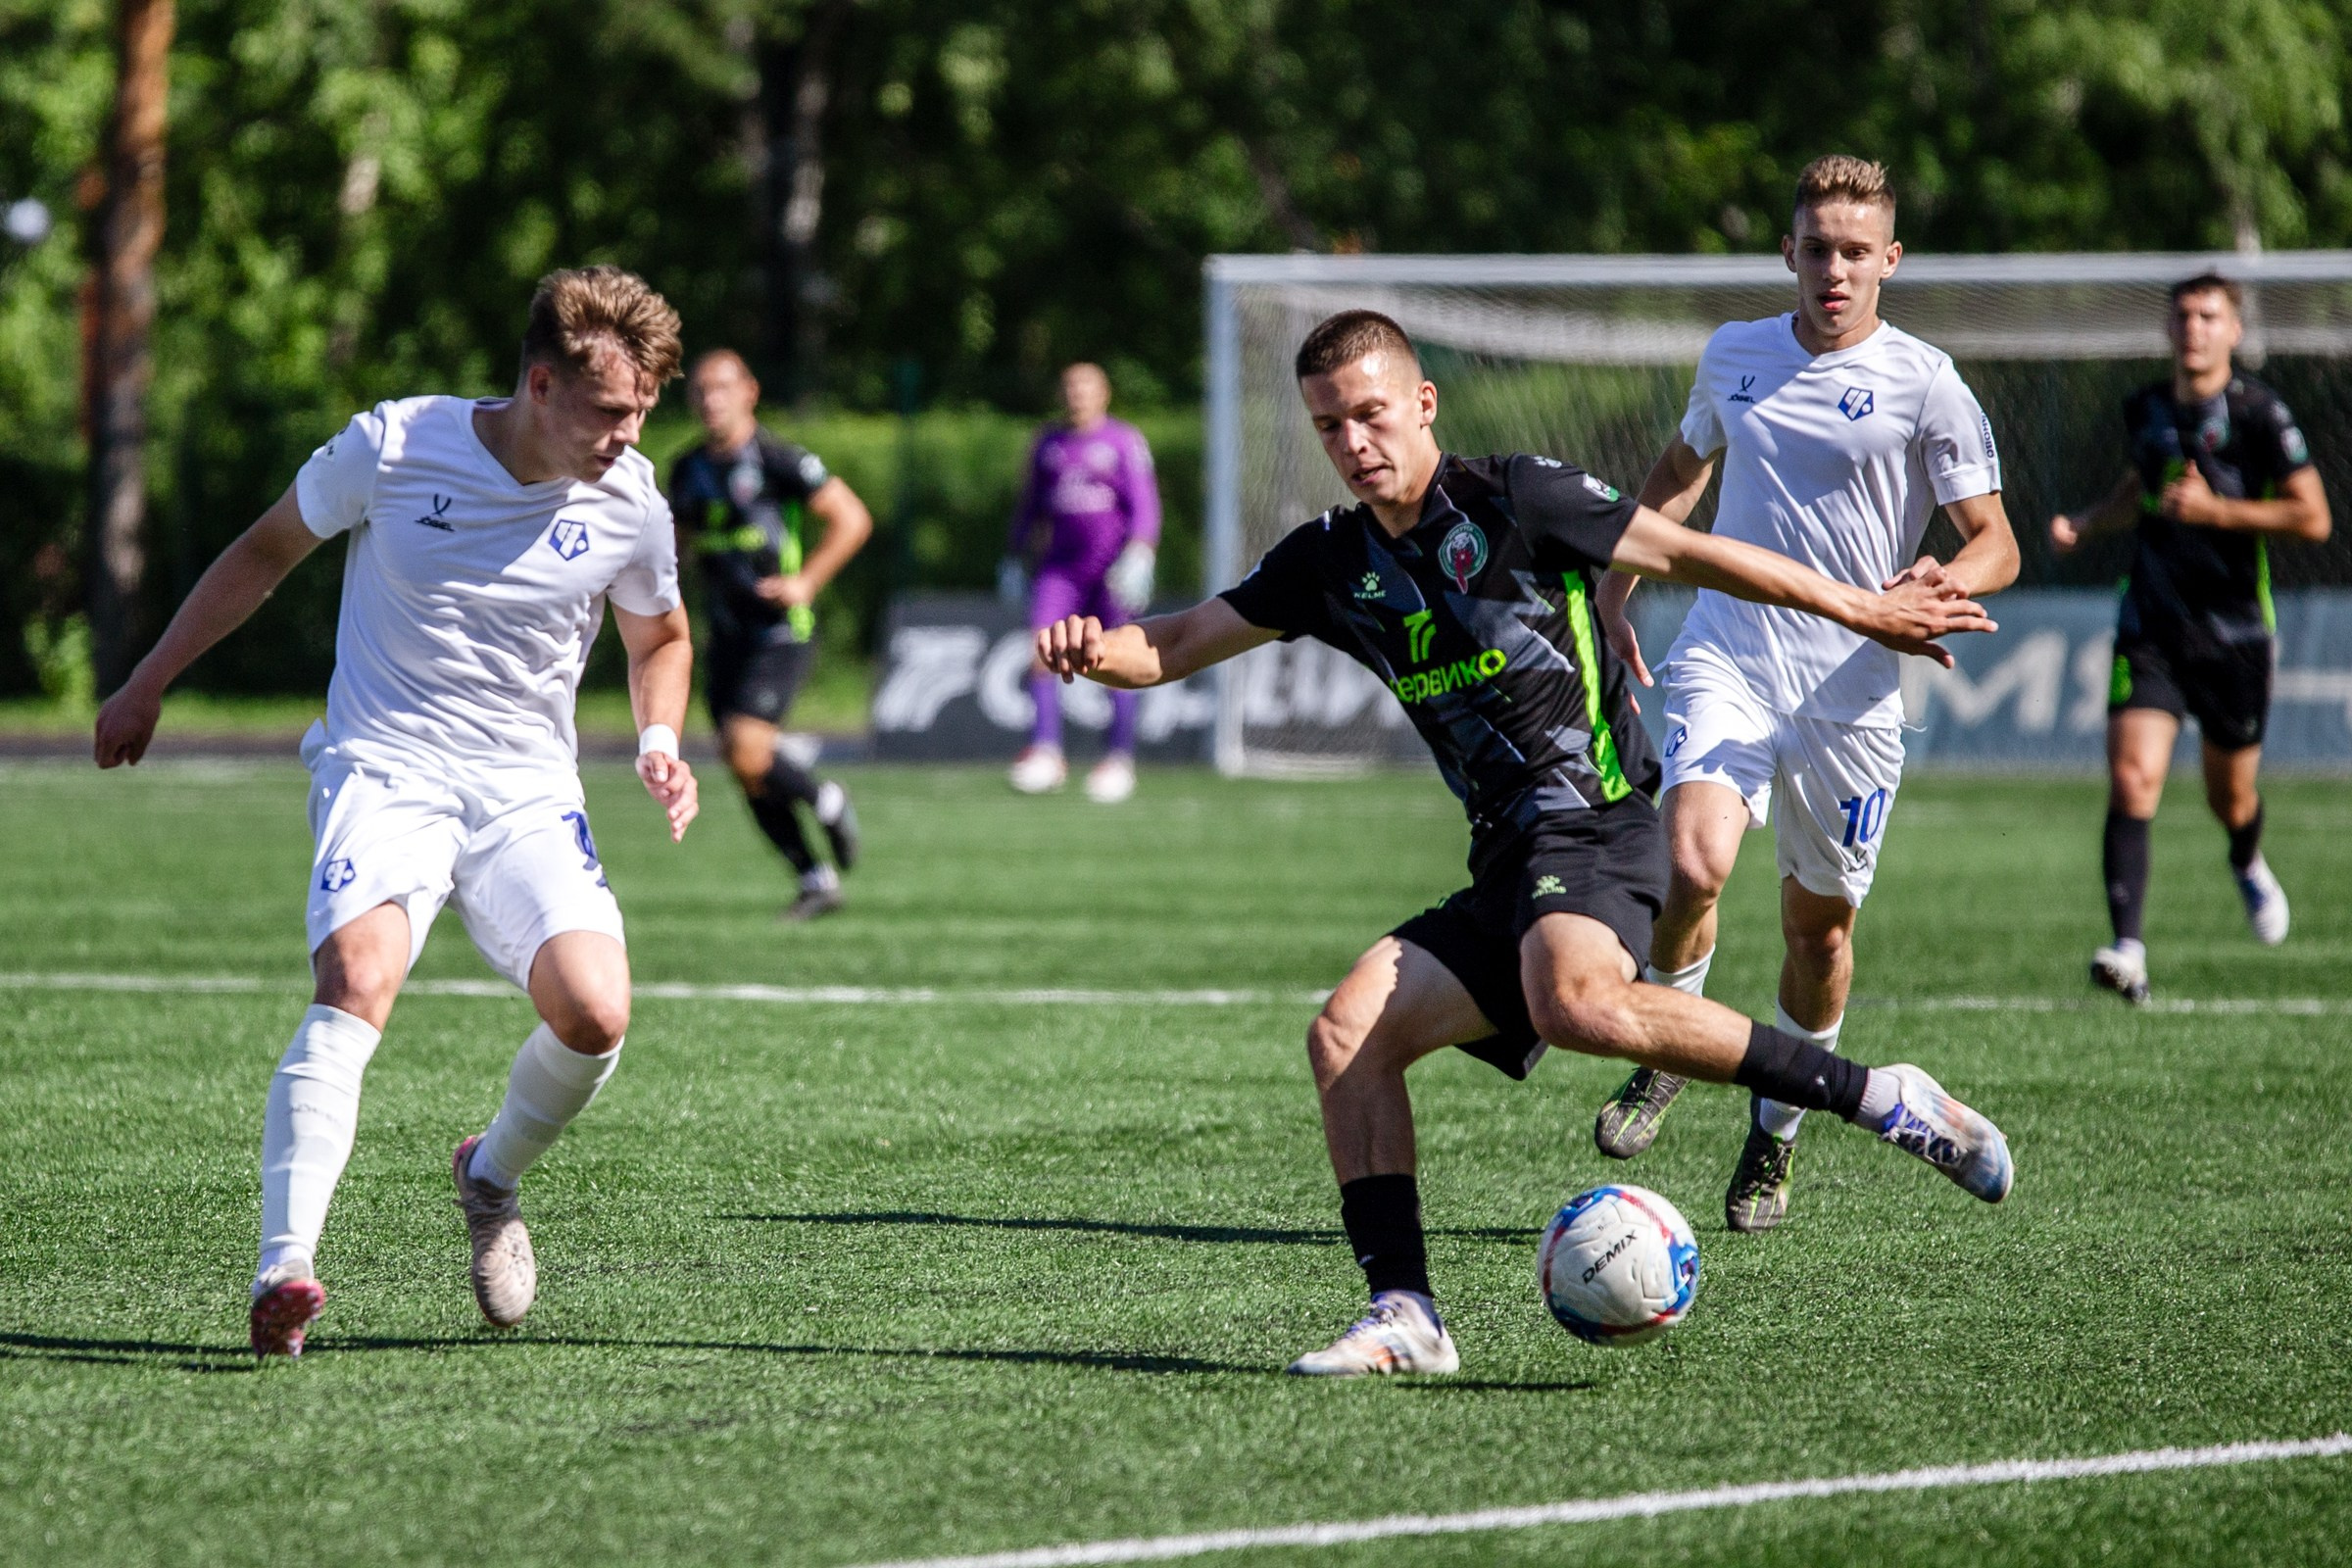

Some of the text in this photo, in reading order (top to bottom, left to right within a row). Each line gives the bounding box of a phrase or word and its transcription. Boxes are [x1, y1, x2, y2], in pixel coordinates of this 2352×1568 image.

[1353, 590, 1387, 599] KELME
[1838, 788, 1886, 848] 10
[1581, 1229, 1638, 1286] DEMIX
